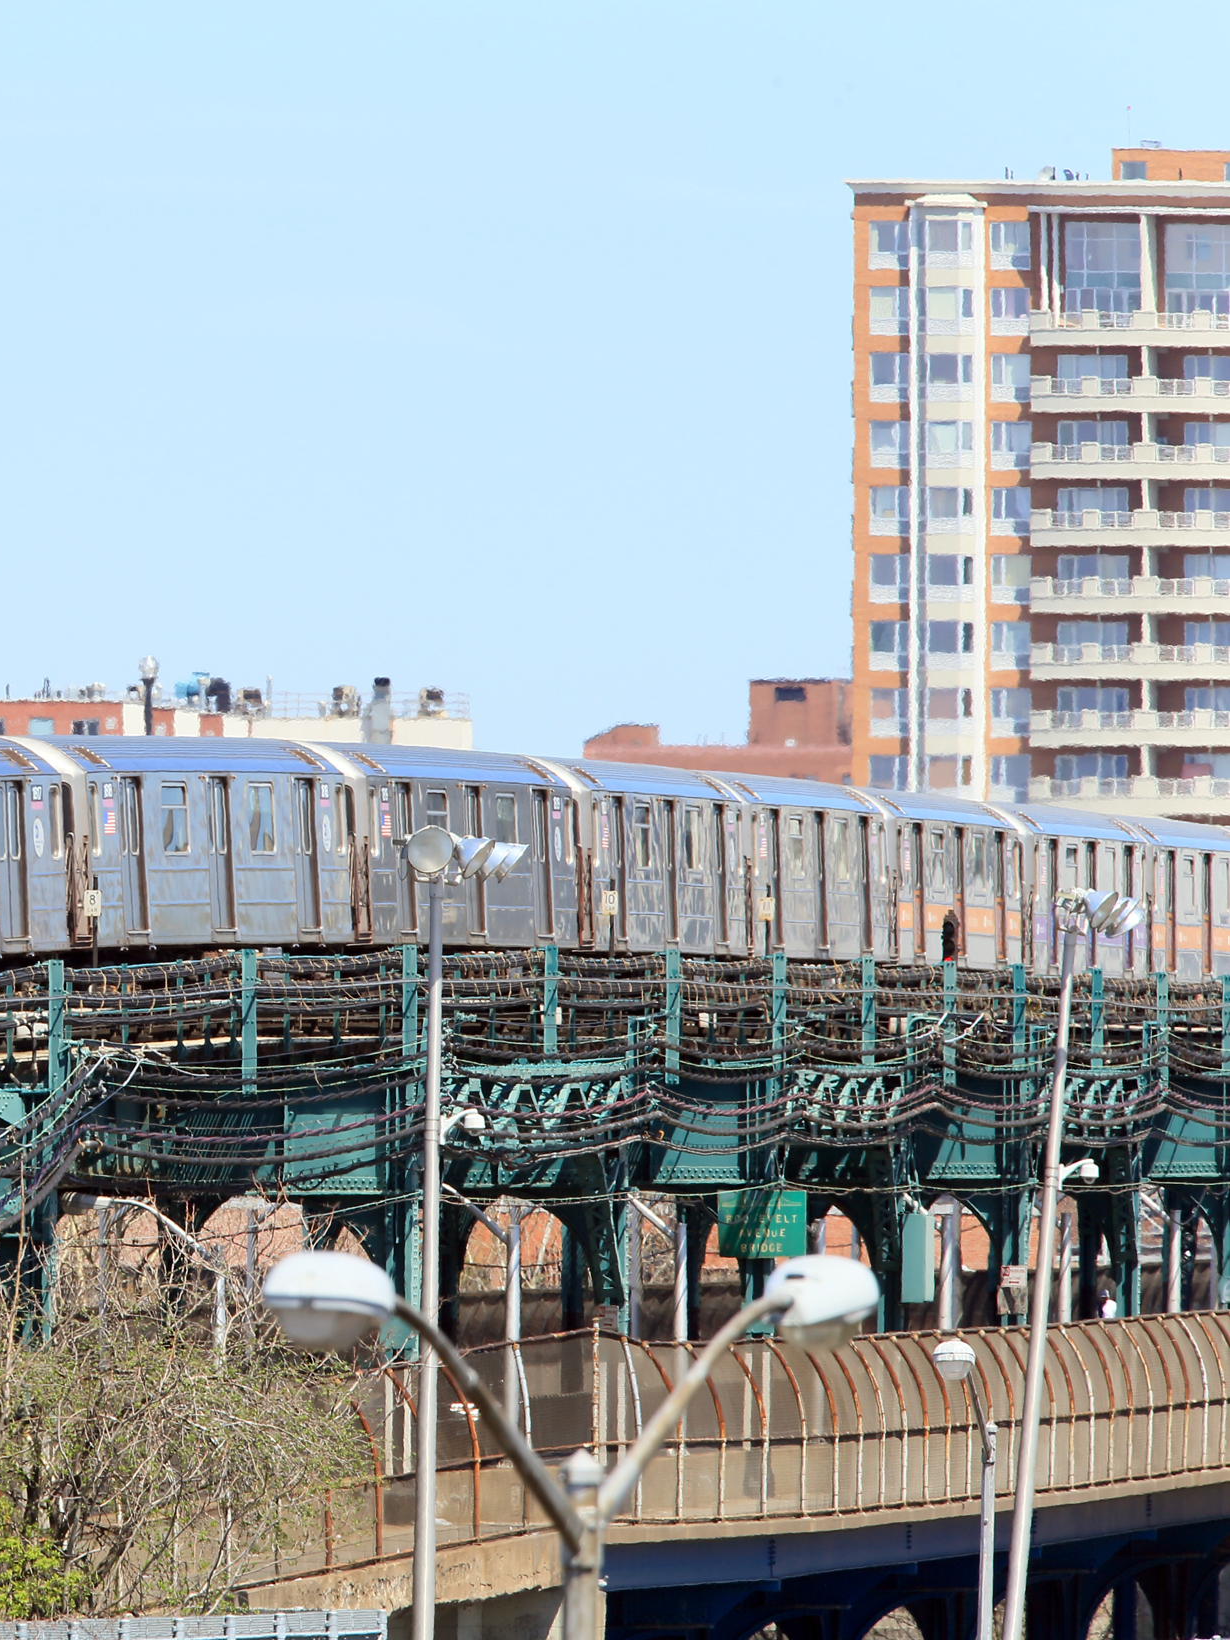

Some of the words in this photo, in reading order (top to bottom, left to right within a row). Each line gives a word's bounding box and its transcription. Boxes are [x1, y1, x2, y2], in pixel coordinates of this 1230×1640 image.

[89, 894, 96, 905] 8
[605, 894, 615, 905] 10
[726, 1214, 797, 1224] ROOEVELT
[739, 1229, 786, 1238] AVENUE
[741, 1243, 783, 1253] BRIDGE
